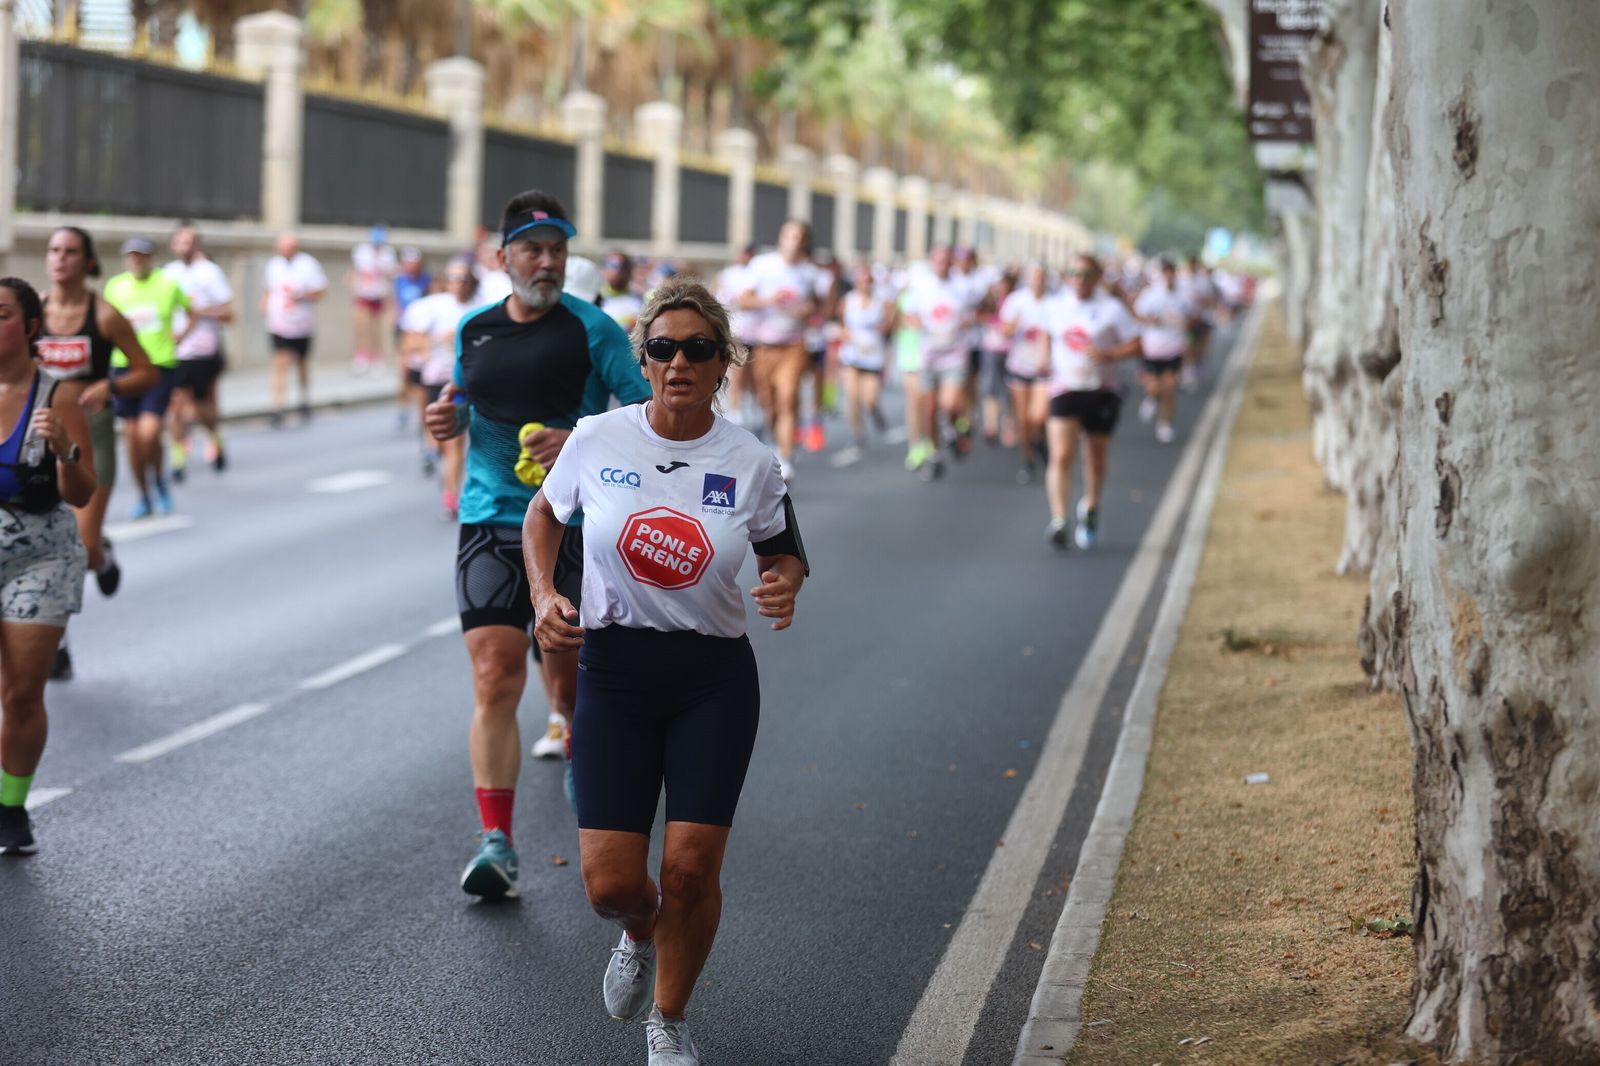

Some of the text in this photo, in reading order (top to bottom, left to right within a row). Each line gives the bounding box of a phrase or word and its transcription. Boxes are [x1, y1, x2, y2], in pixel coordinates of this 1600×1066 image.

[702, 490, 730, 505] AXA
[629, 538, 693, 575] FRENO
[636, 523, 702, 562] PONLE
